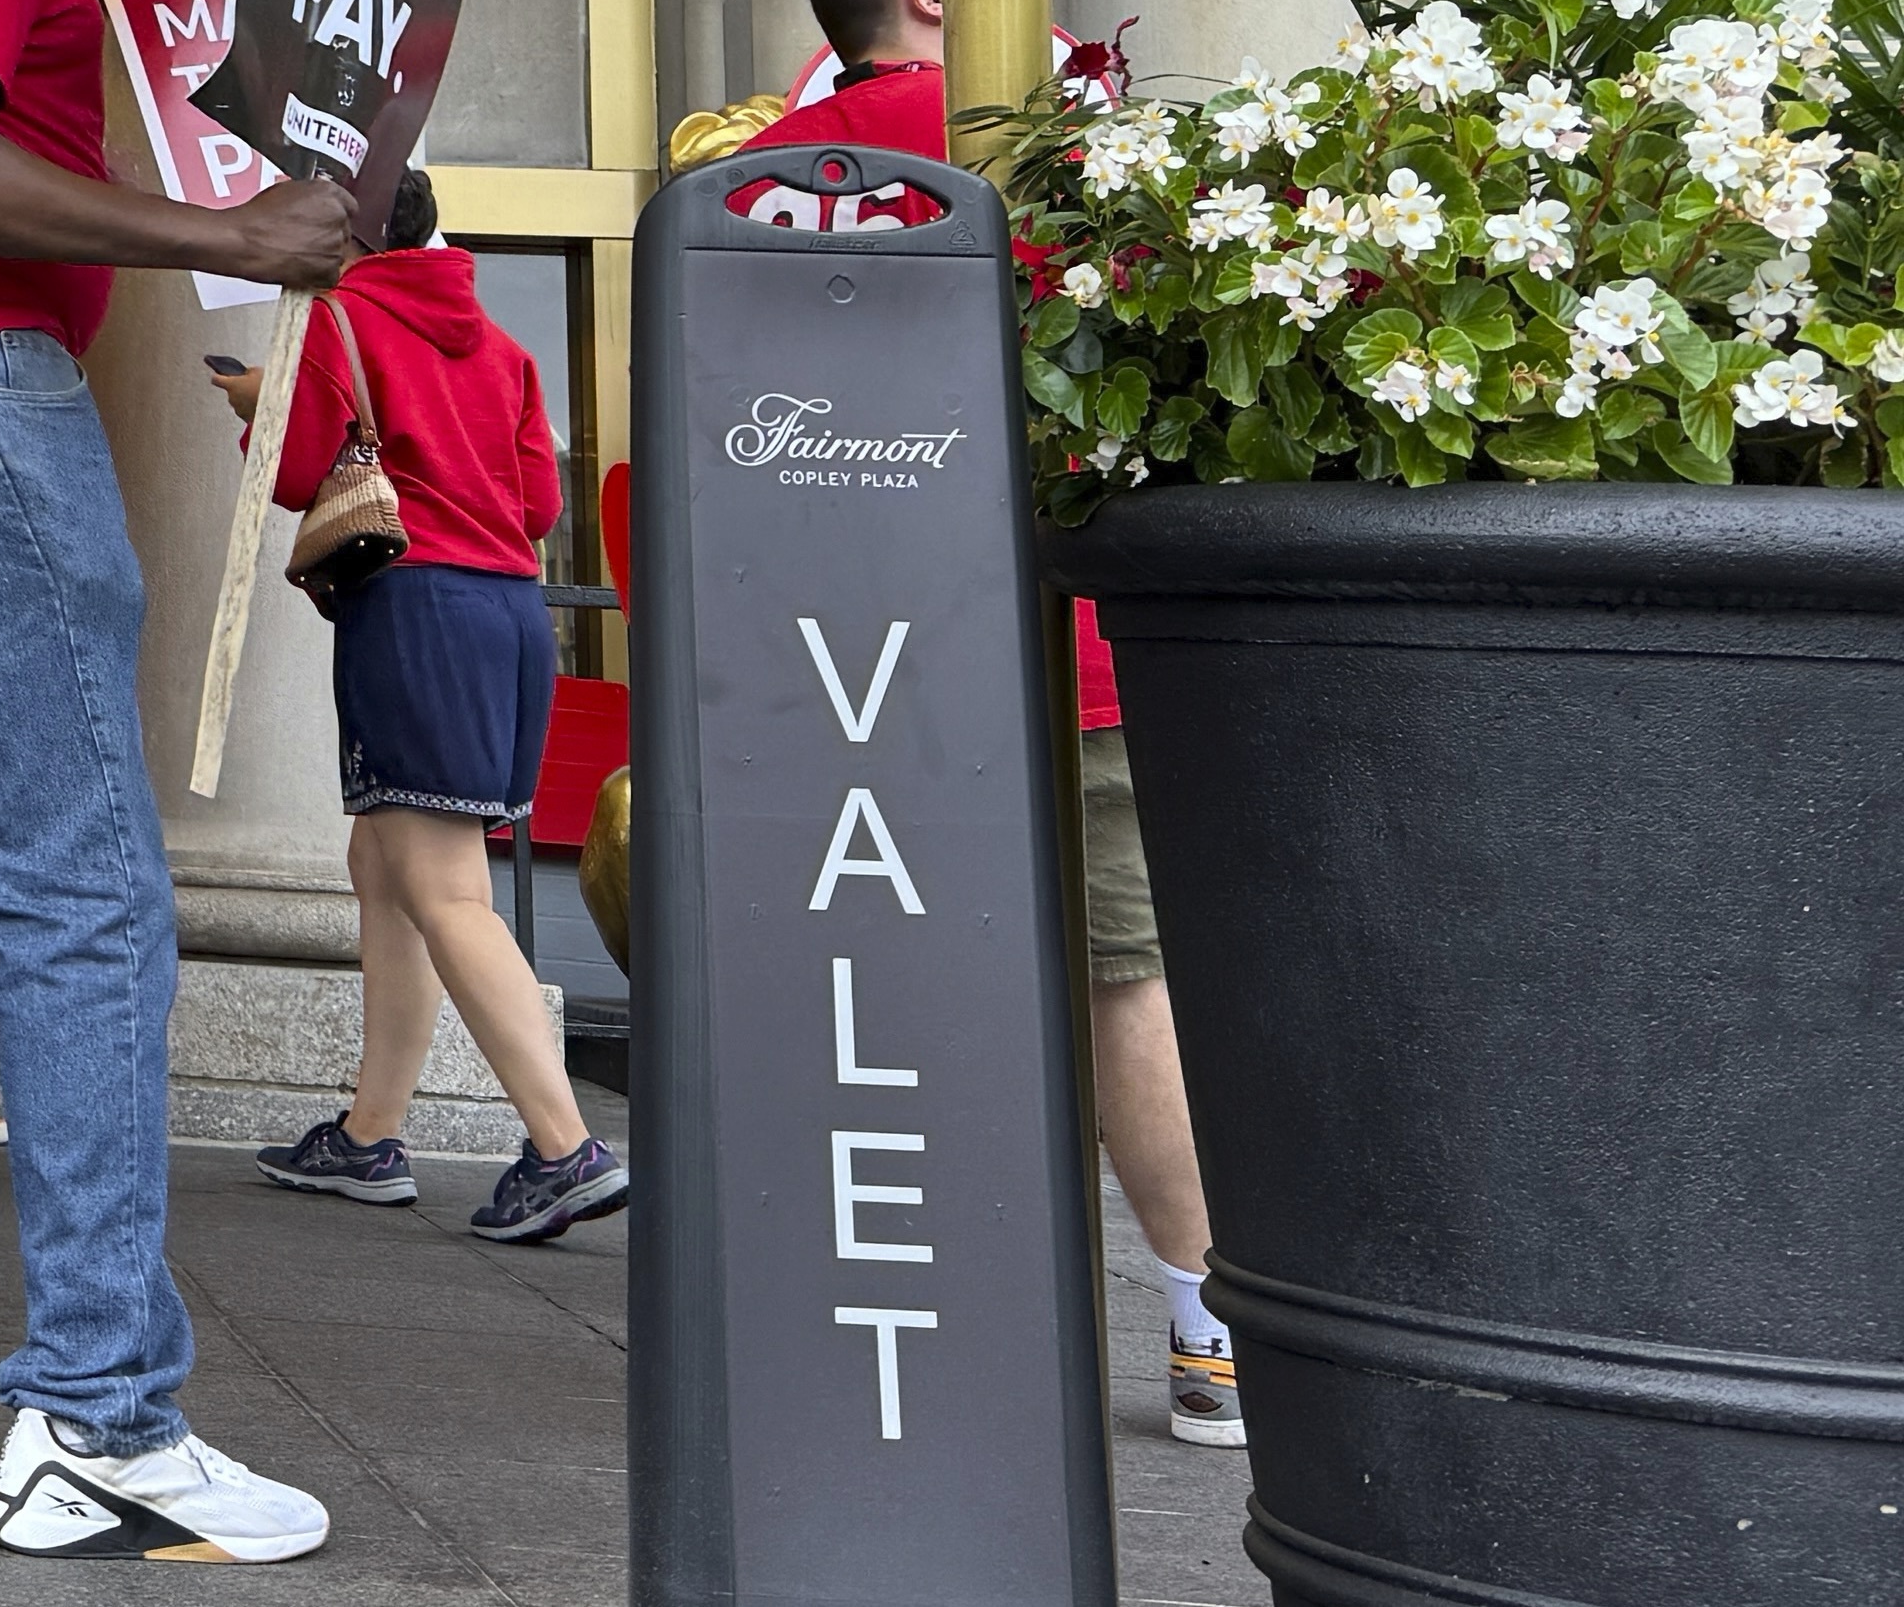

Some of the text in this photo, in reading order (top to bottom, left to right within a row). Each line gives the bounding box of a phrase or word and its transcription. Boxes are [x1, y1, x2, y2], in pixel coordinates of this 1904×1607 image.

[725, 393, 967, 469] Fairmont
[779, 470, 919, 489] COPLEY PLAZA
[797, 617, 938, 1441] VALET
